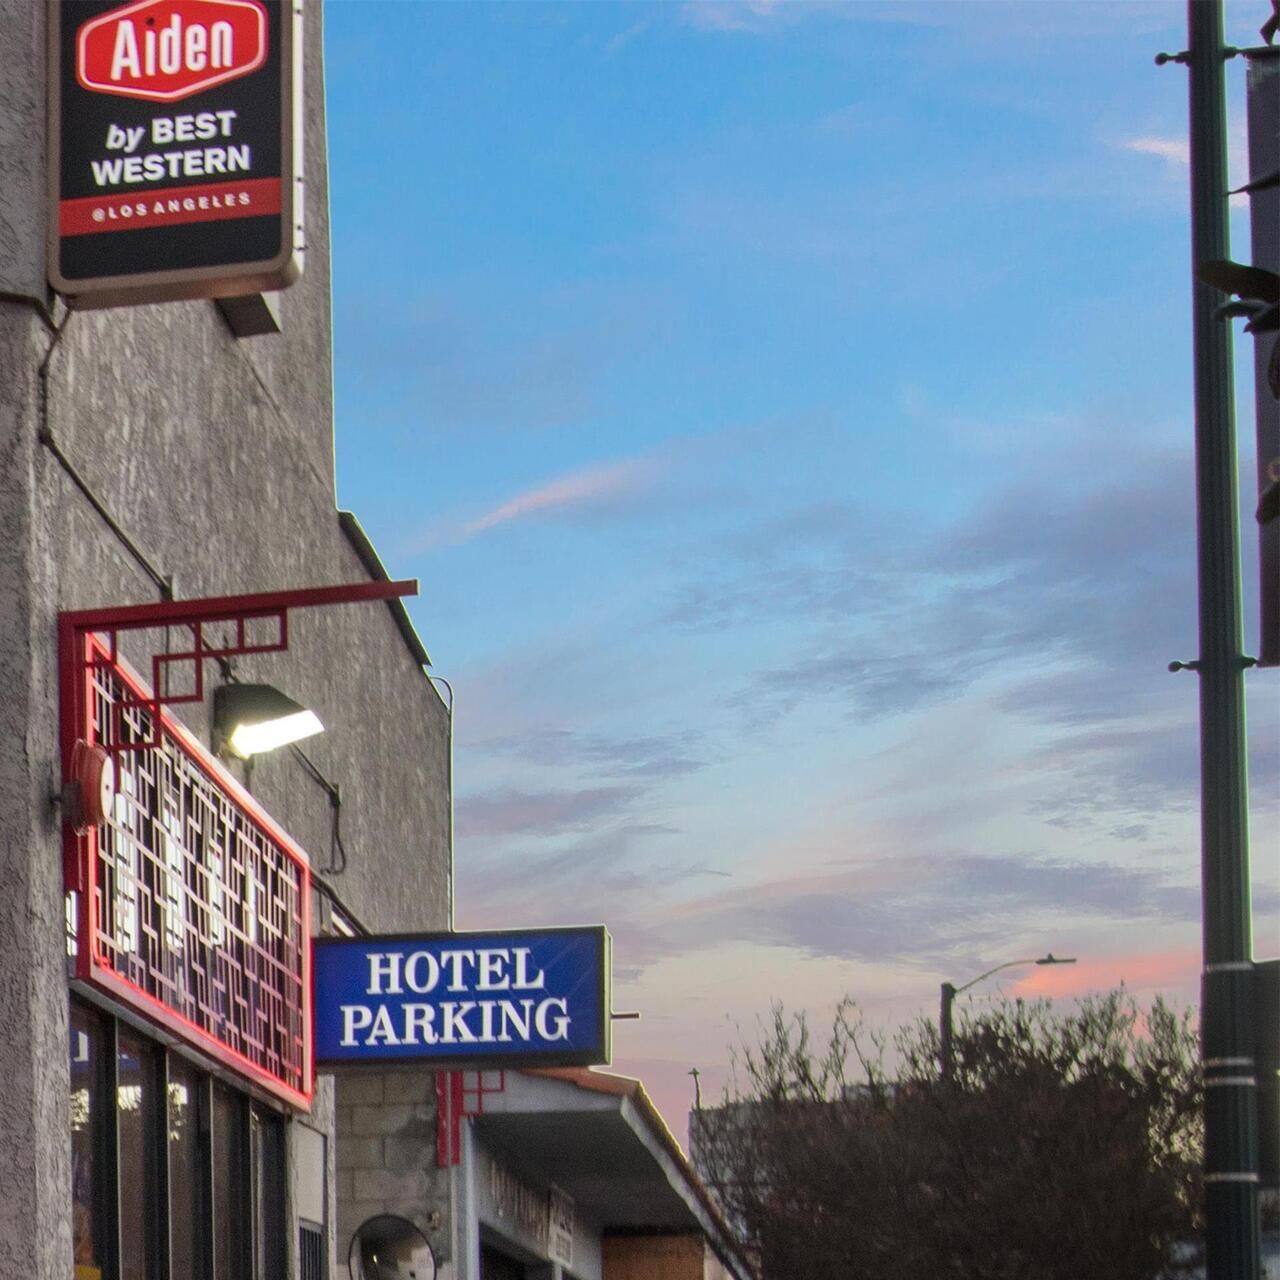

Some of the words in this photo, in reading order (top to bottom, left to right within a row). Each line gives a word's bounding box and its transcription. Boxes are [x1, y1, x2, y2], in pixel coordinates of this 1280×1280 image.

[111, 13, 233, 81] Aiden
[106, 123, 145, 152] by
[151, 110, 237, 144] BEST
[91, 145, 251, 186] WESTERN
[153, 192, 250, 215] ANGELES
[365, 947, 545, 995] HOTEL
[340, 997, 571, 1047] PARKING
